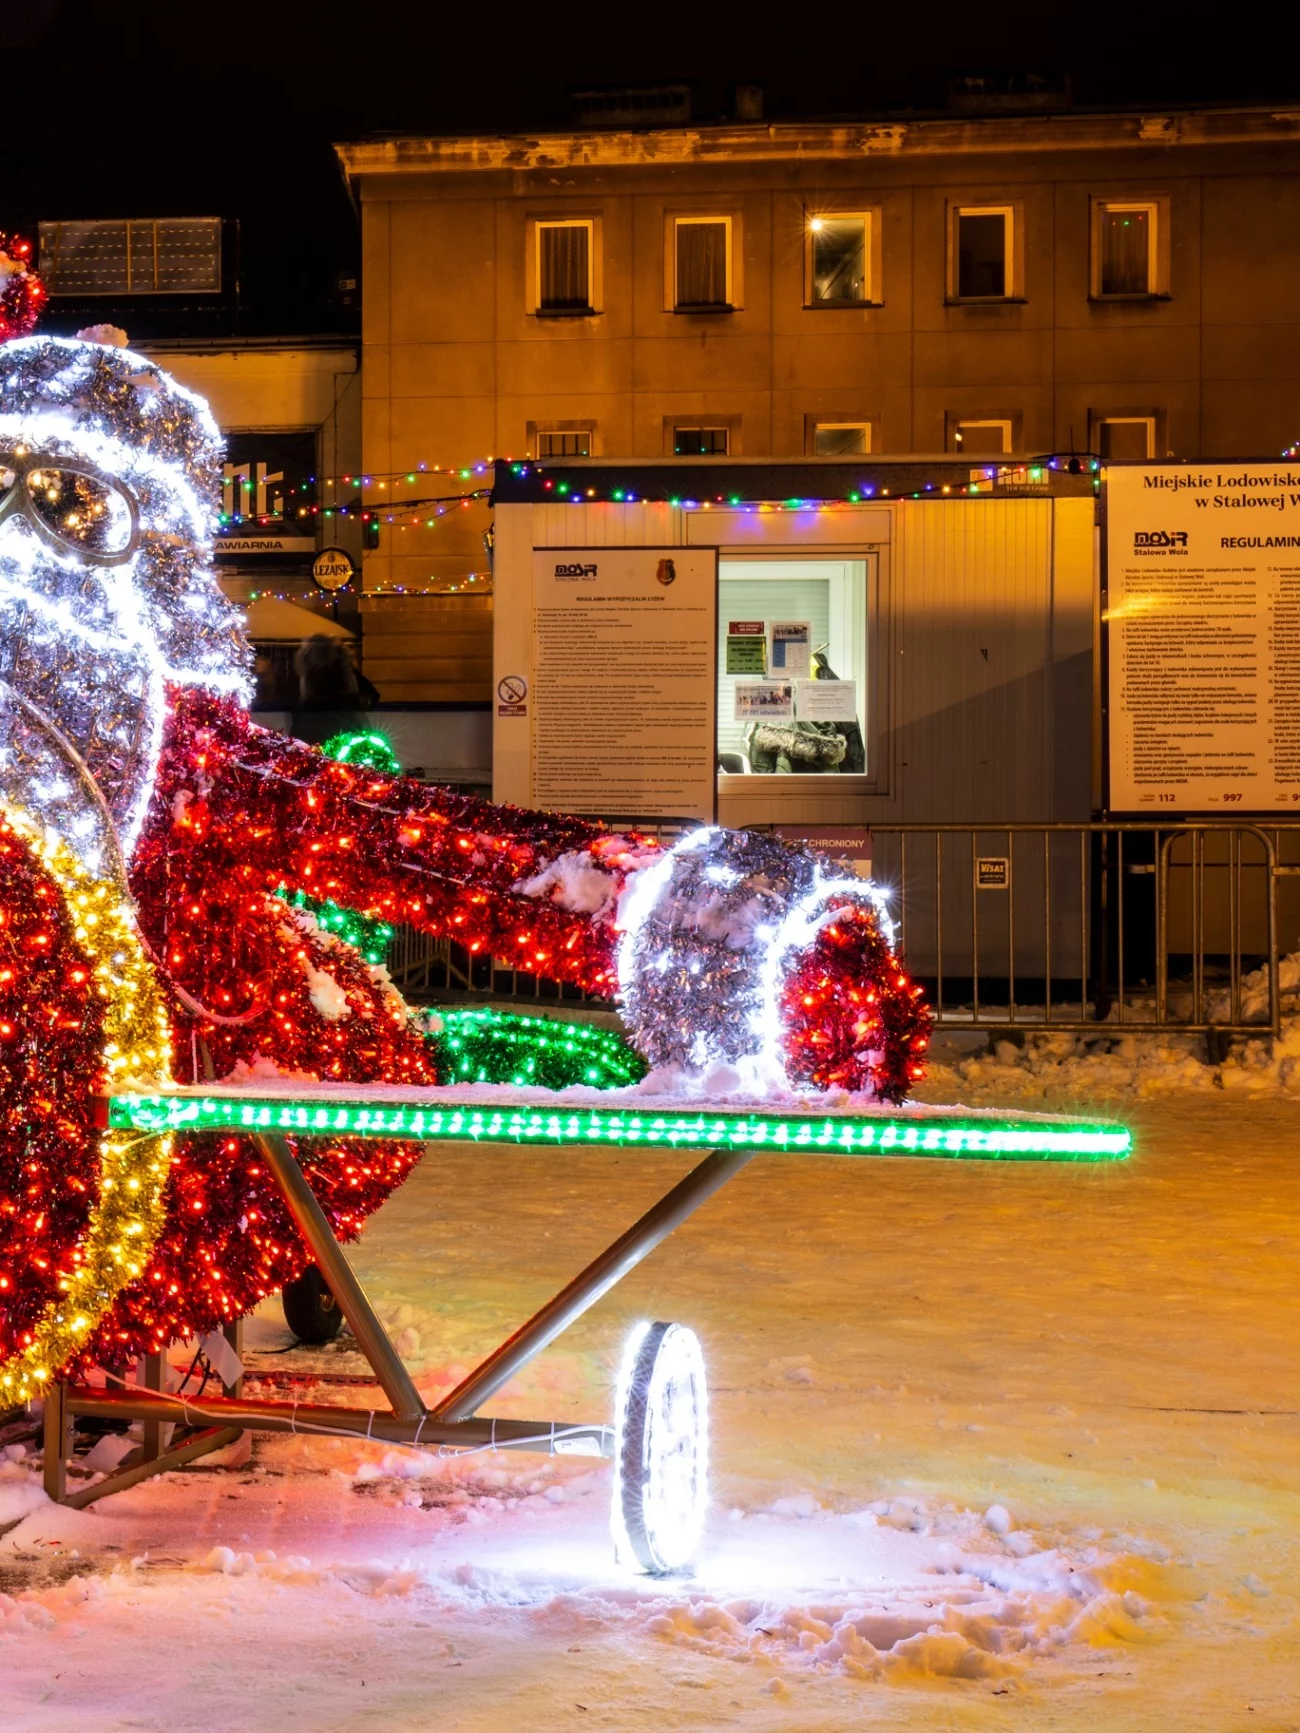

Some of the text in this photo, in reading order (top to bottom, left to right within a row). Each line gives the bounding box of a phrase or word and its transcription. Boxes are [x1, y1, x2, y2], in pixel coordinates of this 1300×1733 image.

[1143, 474, 1212, 492] Miejskie
[1195, 498, 1210, 508] w
[1213, 494, 1285, 511] Stalowej
[216, 541, 283, 549] AWIARNIA
[1221, 536, 1300, 548] REGULAMIN
[1158, 794, 1176, 802] 112
[1223, 793, 1243, 802] 997
